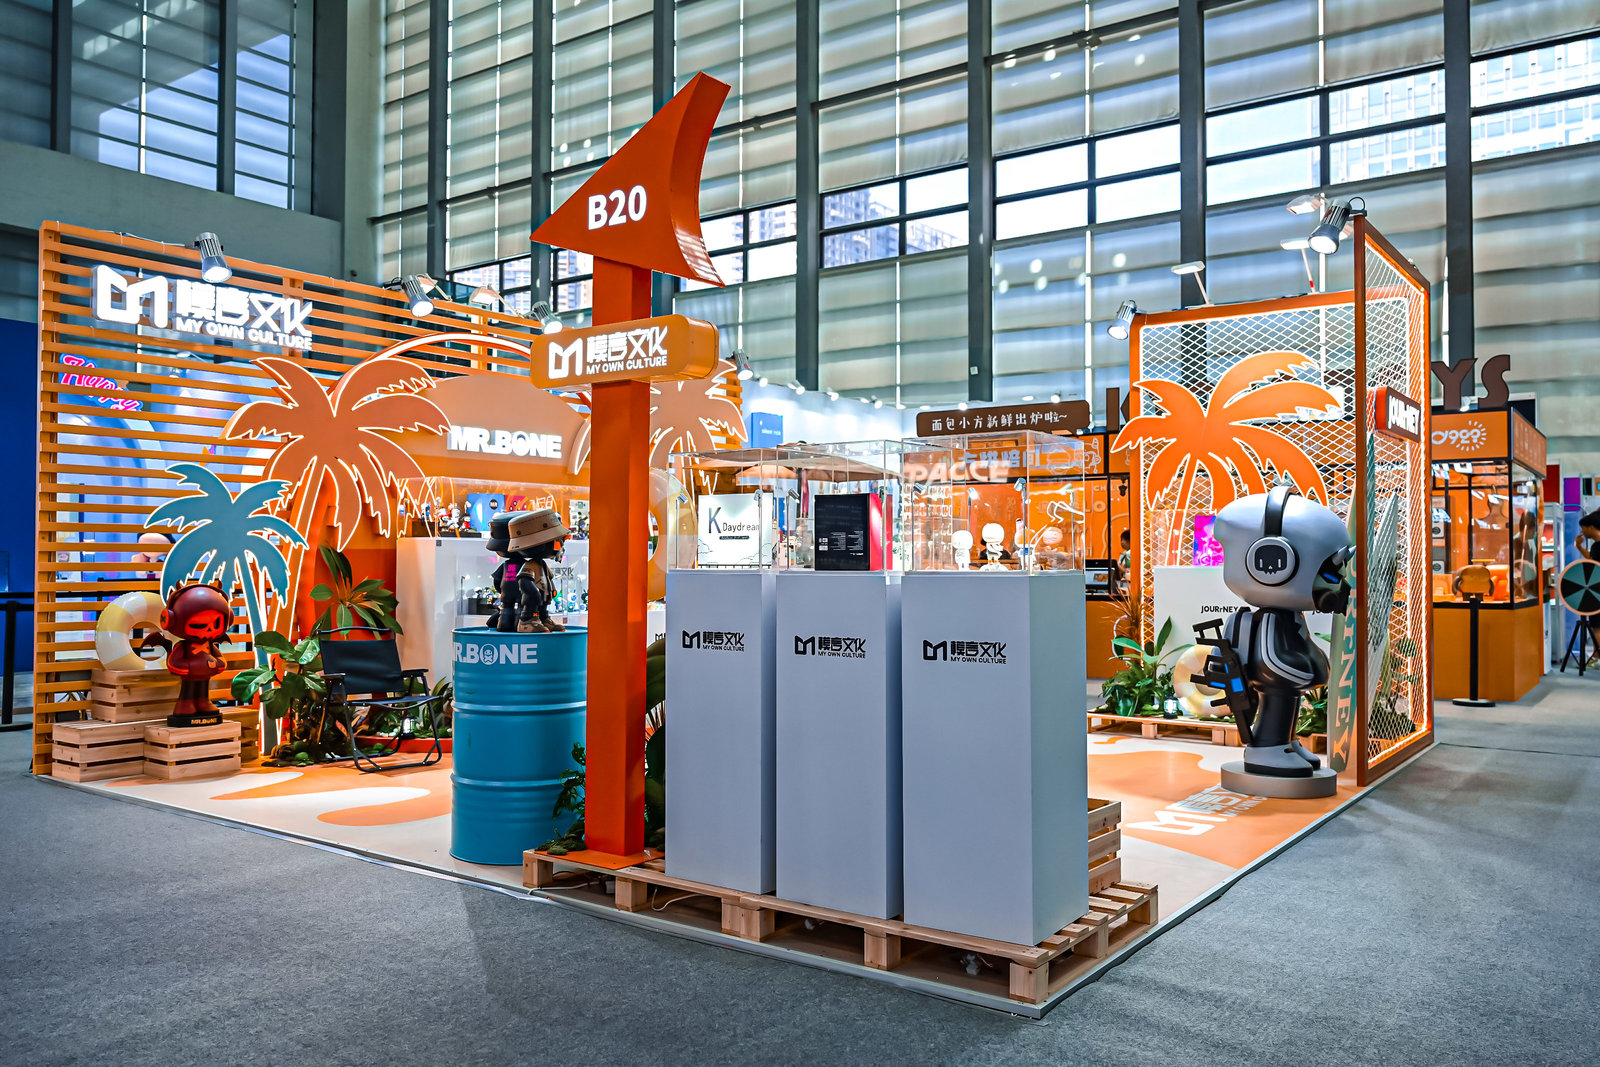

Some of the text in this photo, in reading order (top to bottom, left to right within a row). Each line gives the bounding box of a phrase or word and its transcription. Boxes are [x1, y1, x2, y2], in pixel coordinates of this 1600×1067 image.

[588, 184, 648, 230] B20
[175, 317, 313, 350] MY OWN CULTURE
[586, 355, 668, 375] MY OWN CULTURE
[448, 425, 564, 460] MR.BONE
[454, 642, 539, 666] R.BONE
[723, 645, 745, 653] CULTURE
[978, 657, 1007, 665] CULTURE
